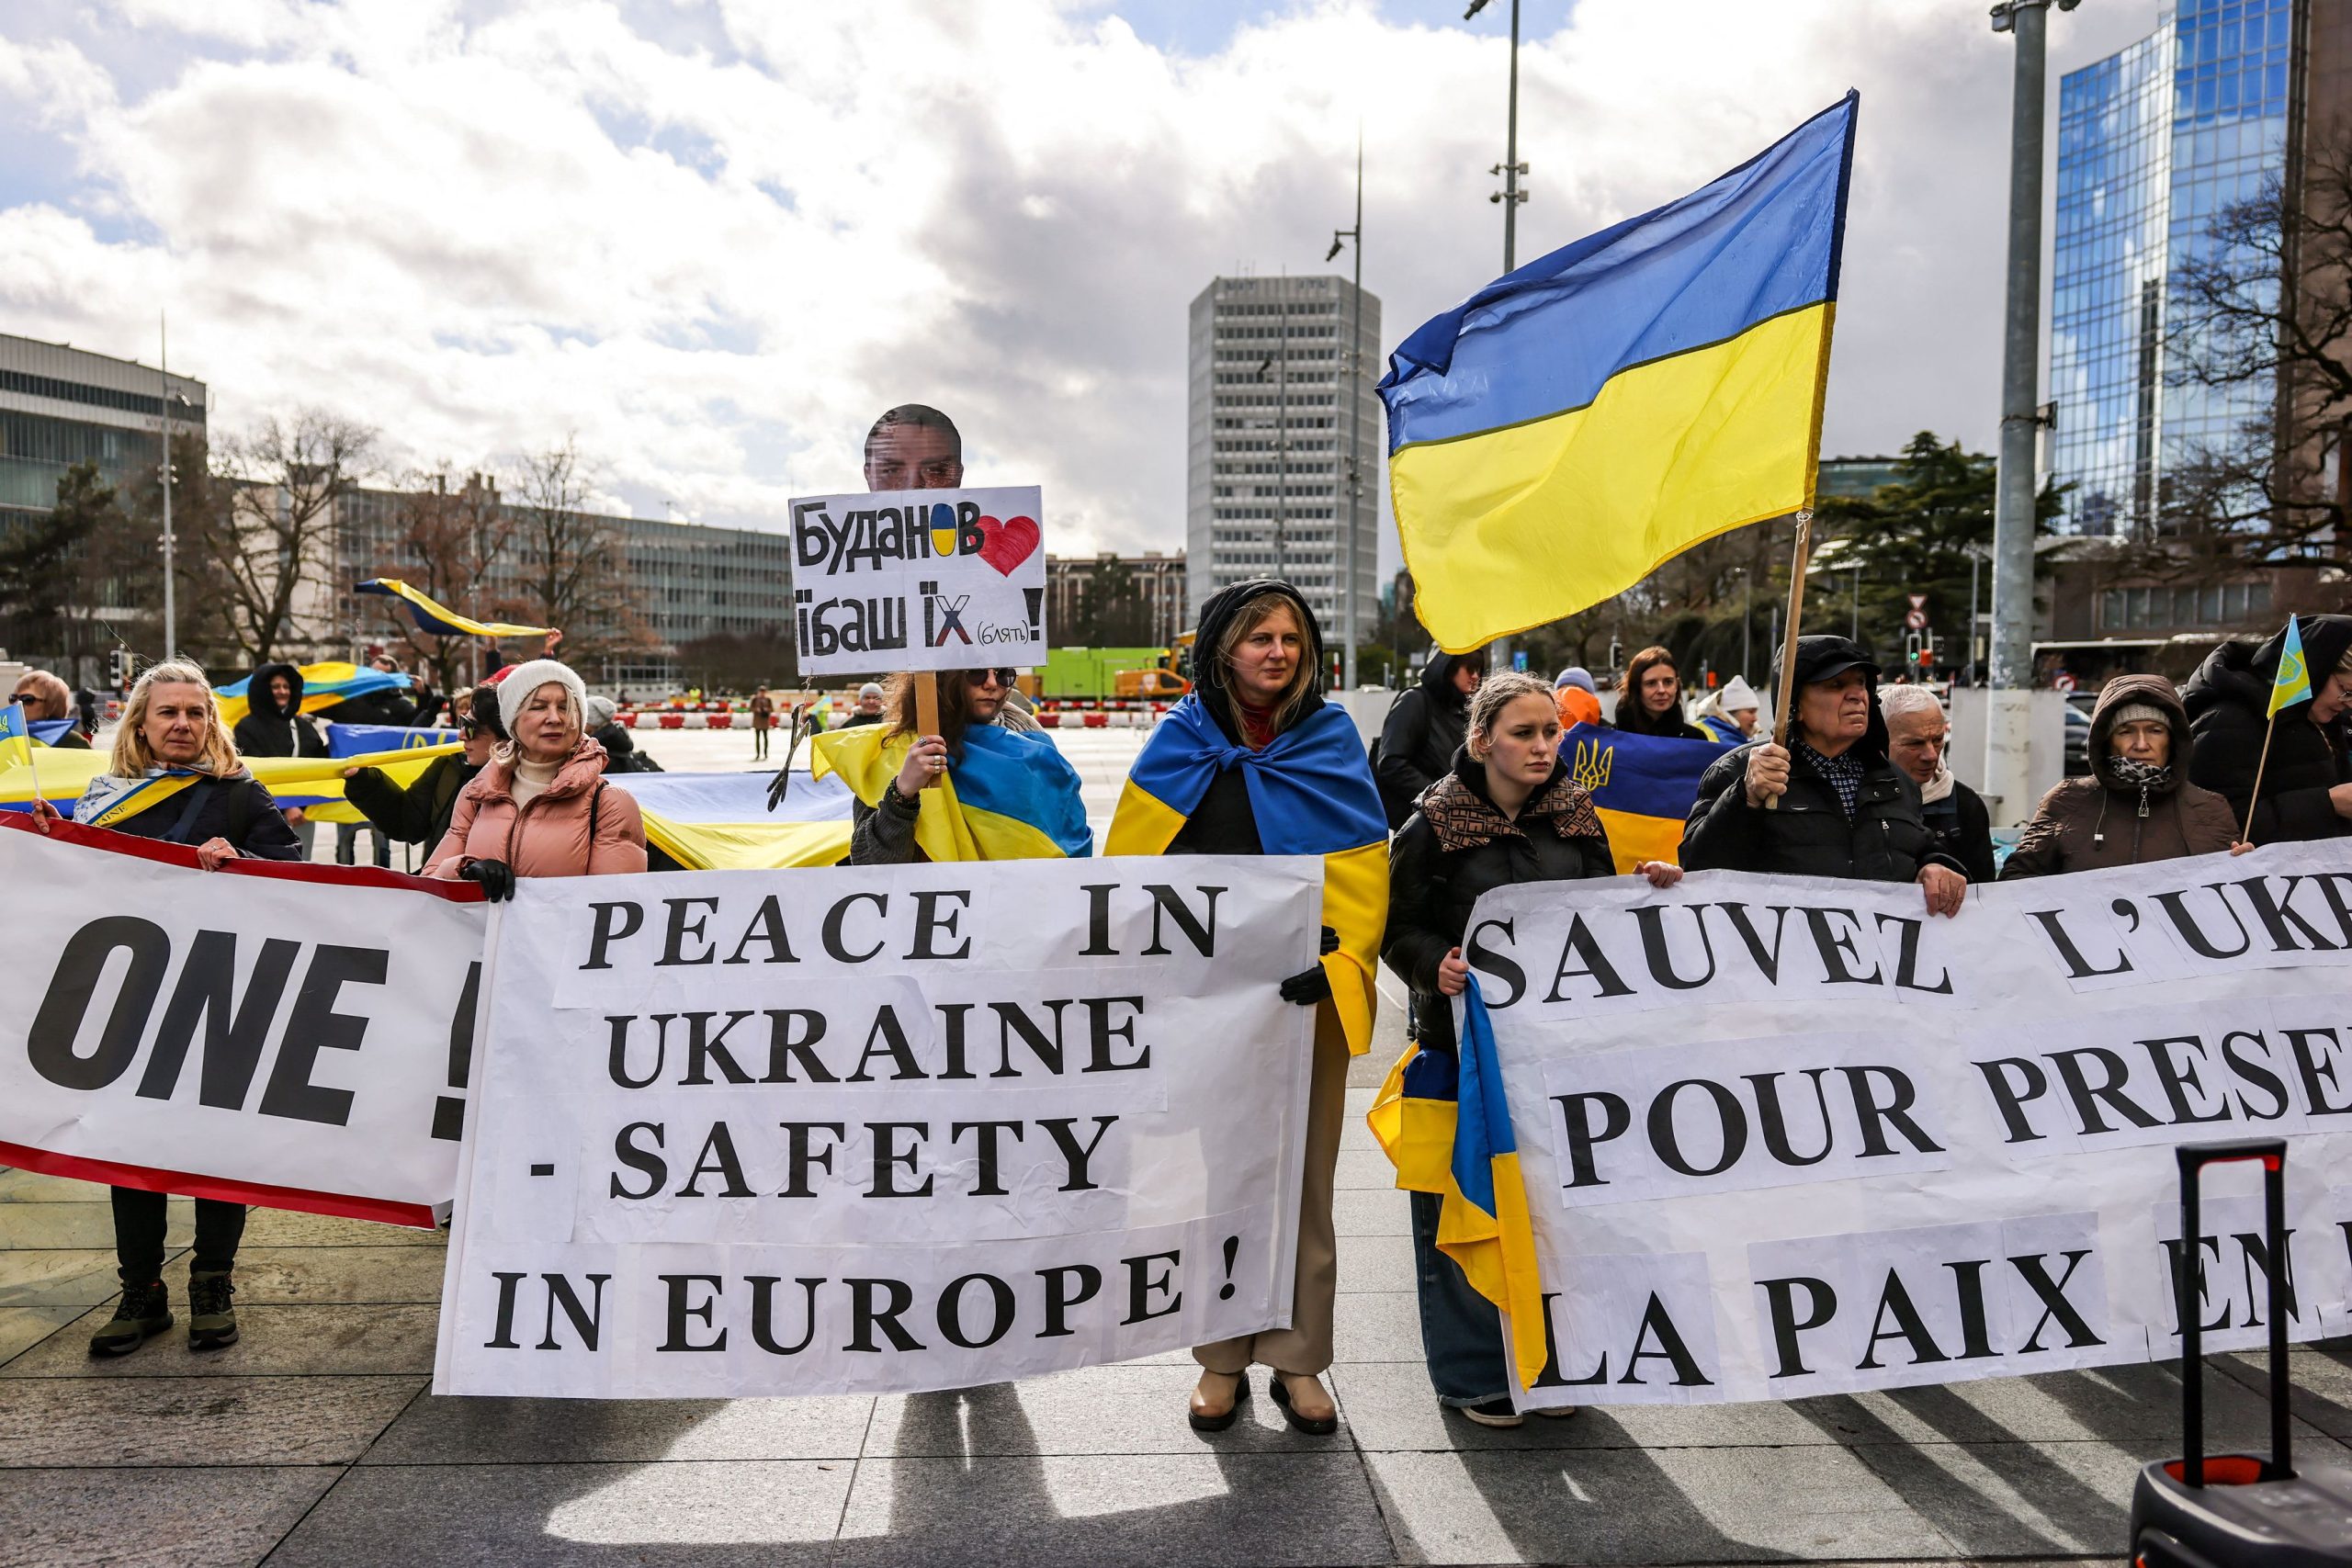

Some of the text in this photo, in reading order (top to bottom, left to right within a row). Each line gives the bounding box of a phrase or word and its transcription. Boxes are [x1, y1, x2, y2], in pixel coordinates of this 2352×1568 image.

[794, 502, 985, 575] Буданов
[796, 589, 907, 657] їбаш
[920, 581, 973, 647] їх
[579, 884, 1228, 970] PEACE IN
[1467, 901, 1953, 1009] SAUVEZ
[28, 916, 390, 1126] ONE
[605, 996, 1150, 1089] UKRAINE
[610, 1116, 1119, 1200] SAFETY
[1550, 1066, 1946, 1189] POUR
[484, 1272, 612, 1351] IN
[657, 1249, 1182, 1356] EUROPE
[1530, 1290, 1714, 1388] LA
[1755, 1250, 2107, 1378] PAIX
[2159, 1228, 2300, 1336] EN
